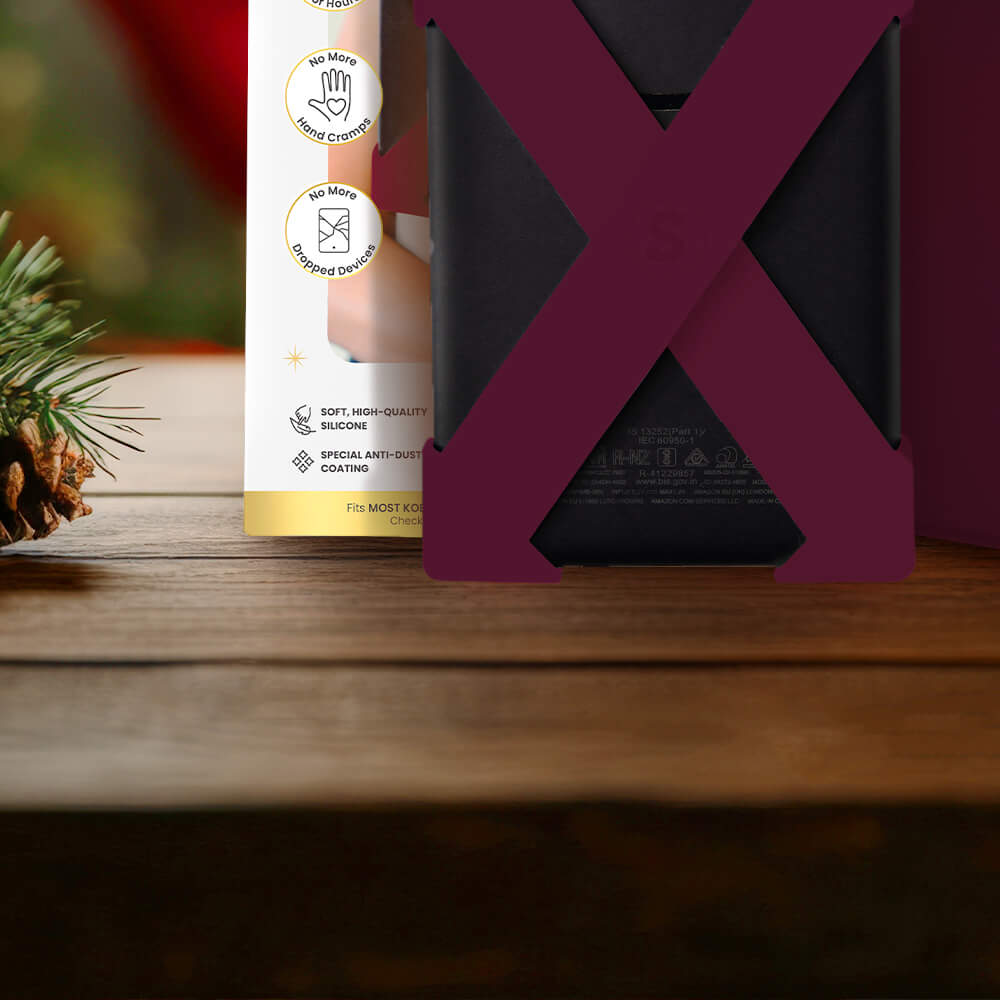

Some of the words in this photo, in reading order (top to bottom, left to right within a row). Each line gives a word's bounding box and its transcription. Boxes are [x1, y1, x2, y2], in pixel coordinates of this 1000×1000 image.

[308, 55, 325, 67] No
[328, 52, 357, 66] More
[296, 116, 326, 140] Hand
[327, 117, 372, 142] Cramps
[308, 189, 325, 201] No
[328, 186, 357, 200] More
[292, 243, 335, 276] Dropped
[337, 244, 376, 276] Devices
[320, 407, 350, 417] SOFT,
[352, 407, 428, 417] HIGH-QUALITY
[320, 421, 368, 430] SILICONE
[320, 450, 363, 459] SPECIAL
[364, 450, 422, 459] ANTI-DUST
[320, 464, 369, 473] COATING
[346, 503, 365, 513] Fits
[368, 503, 400, 513] MOST
